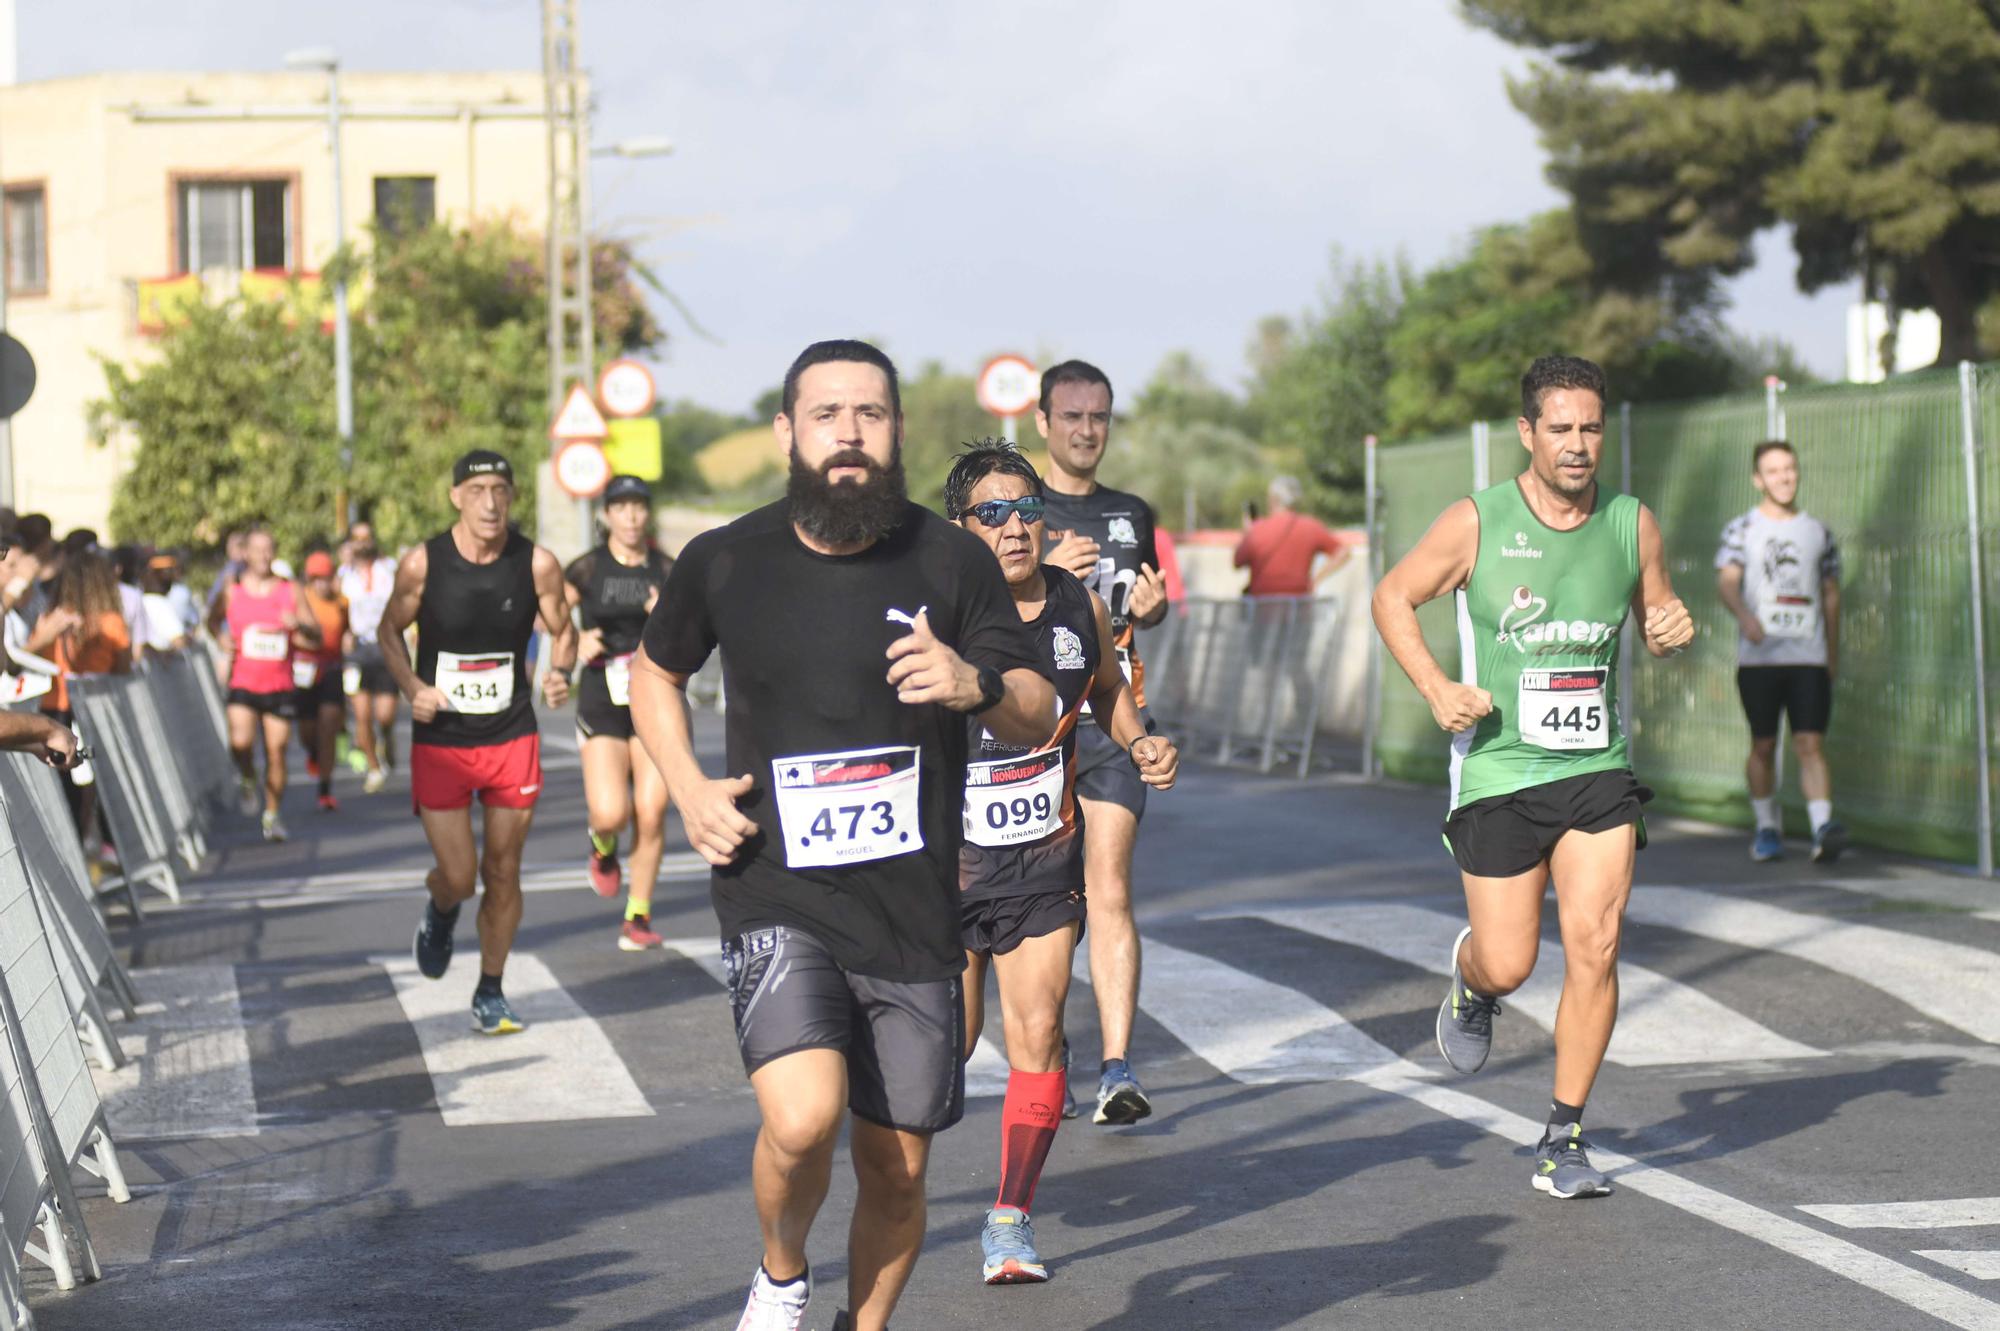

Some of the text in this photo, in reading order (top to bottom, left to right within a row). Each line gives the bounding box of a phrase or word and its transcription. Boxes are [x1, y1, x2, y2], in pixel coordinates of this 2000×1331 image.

[1502, 546, 1543, 558] korridor
[601, 576, 650, 605] PUM
[452, 682, 498, 700] 434
[1541, 706, 1601, 732] 445
[991, 761, 1047, 783] NONDUERMAS
[810, 801, 895, 842] 473
[986, 793, 1051, 830] 099
[1001, 827, 1045, 840] FERNANDO
[836, 846, 875, 857] MIGUEL
